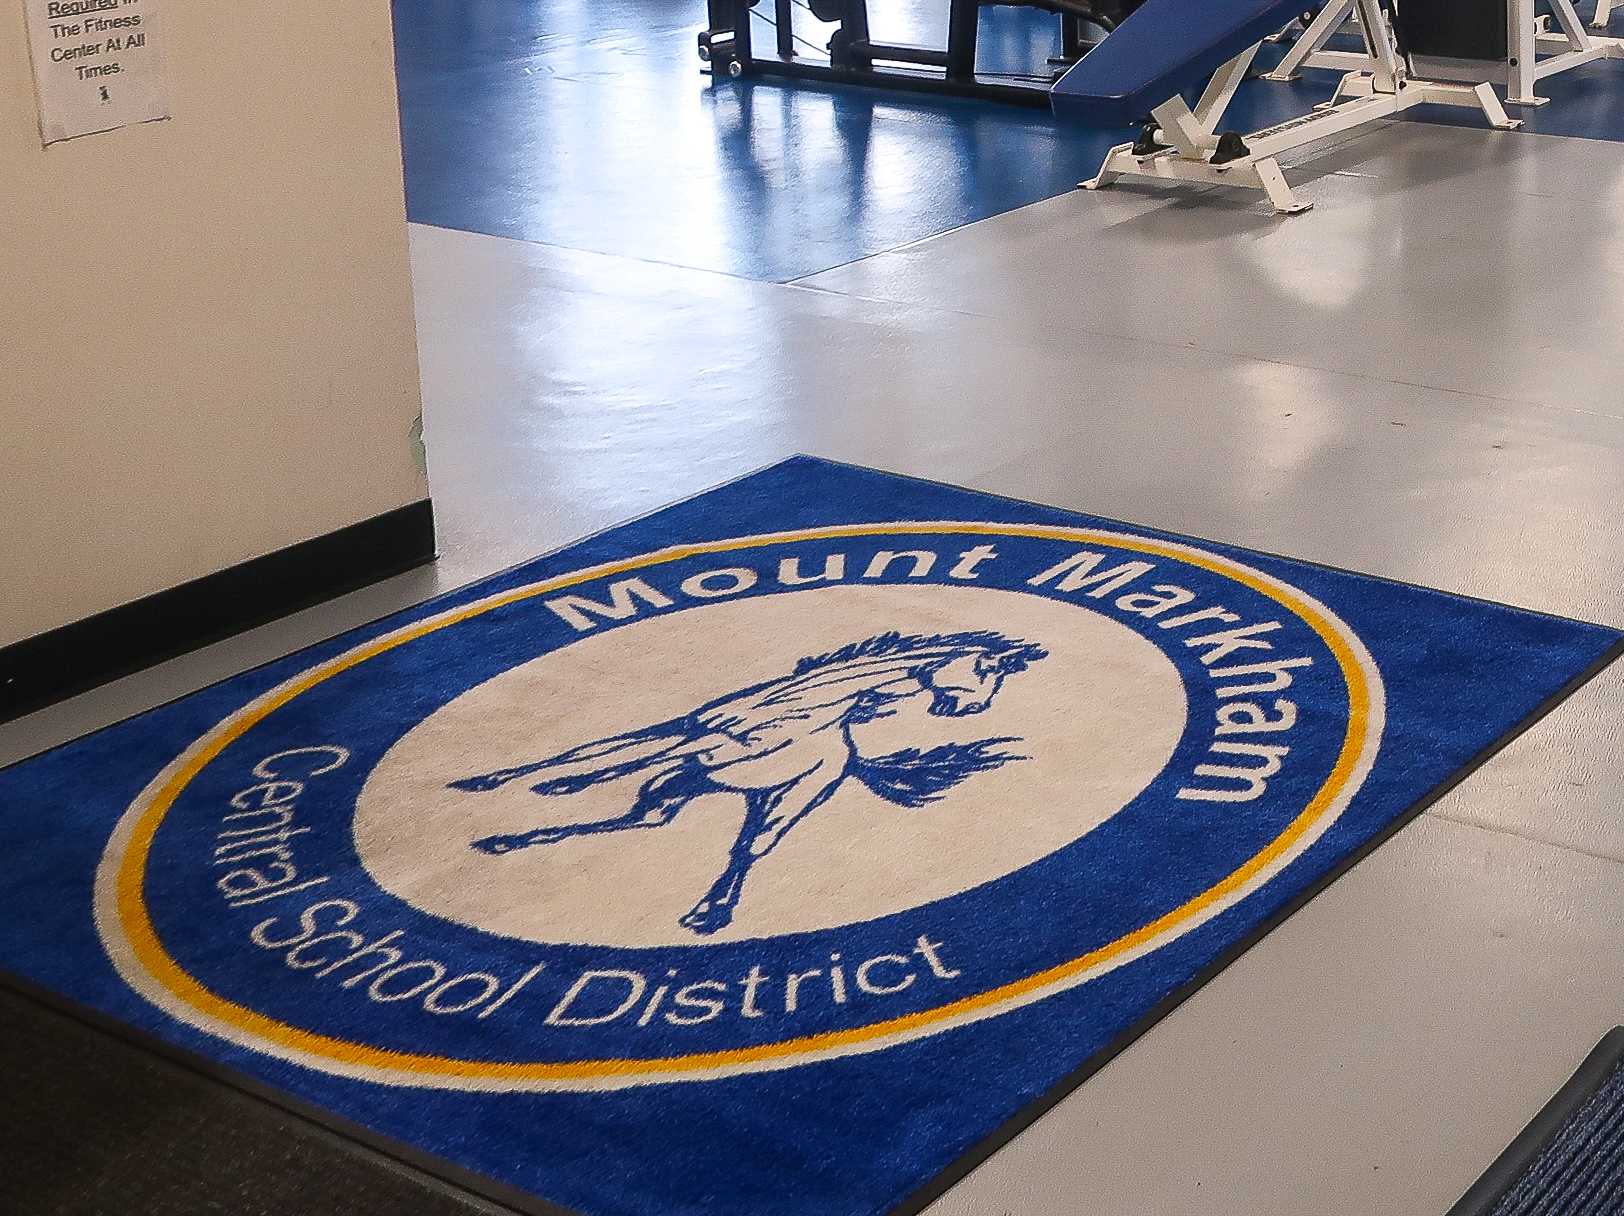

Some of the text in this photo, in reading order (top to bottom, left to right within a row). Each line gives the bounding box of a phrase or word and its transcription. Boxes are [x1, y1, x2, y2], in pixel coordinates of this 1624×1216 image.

[49, 15, 141, 39] The Fitness
[51, 33, 146, 62] Center At All
[75, 63, 125, 80] Times.
[542, 541, 1317, 804] Mount Markham
[211, 742, 964, 1028] Central School District
